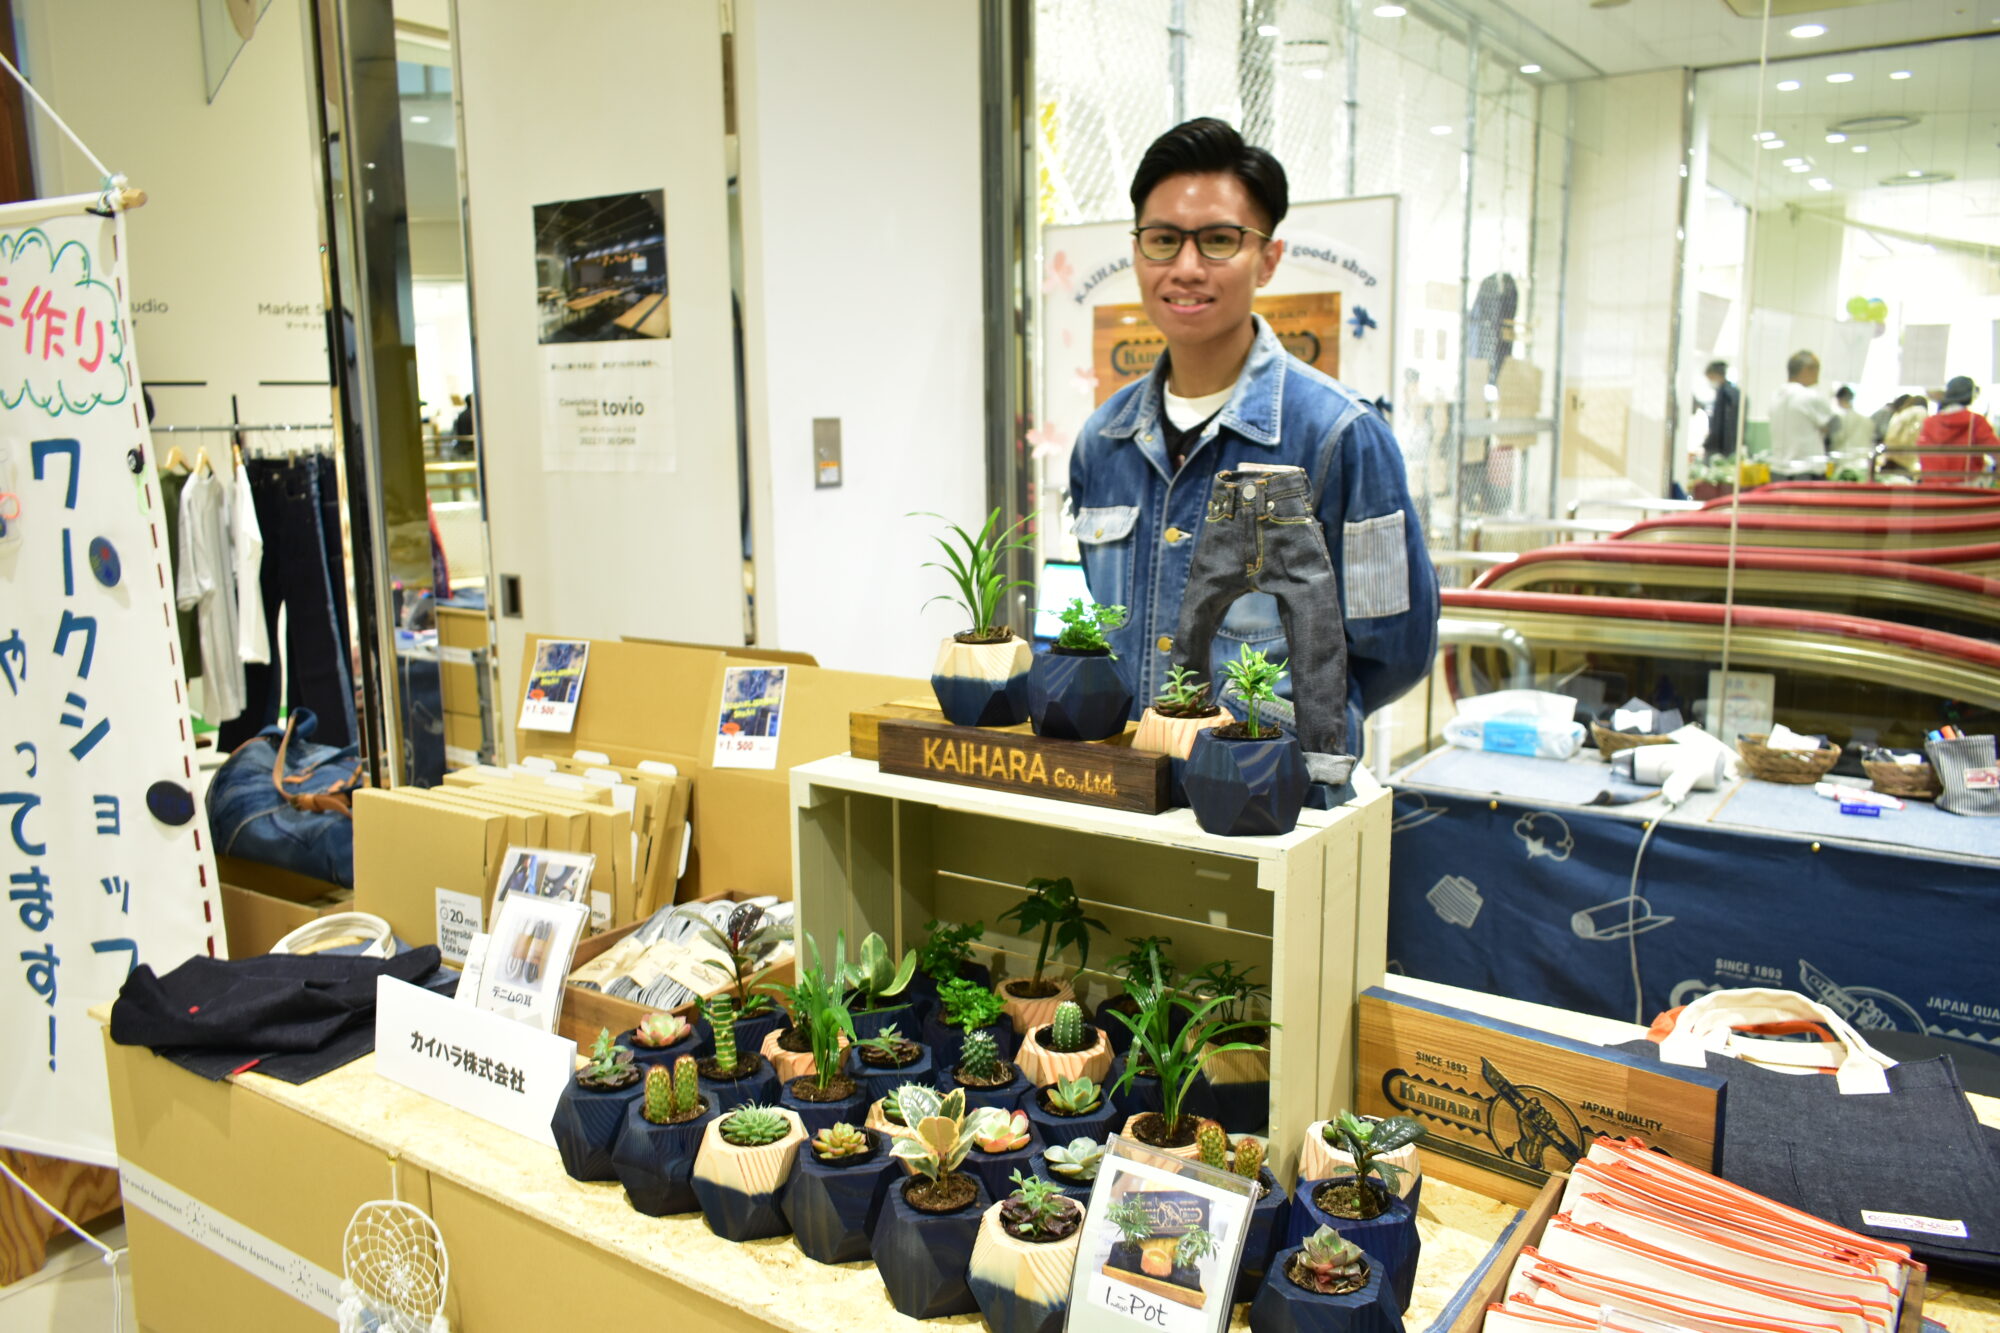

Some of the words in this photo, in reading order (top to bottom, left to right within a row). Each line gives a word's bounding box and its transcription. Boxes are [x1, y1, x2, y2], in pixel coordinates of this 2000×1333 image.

[1292, 245, 1338, 264] goods
[1342, 258, 1377, 287] shop
[1074, 257, 1134, 304] KAIHAR
[130, 298, 169, 313] udio
[258, 302, 310, 316] Market
[602, 395, 644, 416] tovio
[923, 737, 1049, 785] KAIHARA
[450, 908, 464, 924] 20
[464, 918, 478, 928] min
[441, 924, 473, 940] Reversibl
[1715, 958, 1750, 974] SINCE
[1754, 965, 1782, 980] 1893
[1926, 996, 1969, 1014] JAPAN
[411, 1030, 526, 1094] カイハラ株式会社
[1416, 1051, 1442, 1067] SINCE
[1446, 1060, 1468, 1074] 1893
[1399, 1080, 1481, 1123] KAIHARA
[1580, 1100, 1614, 1118] JAPAN
[1617, 1110, 1663, 1132] QUALITY
